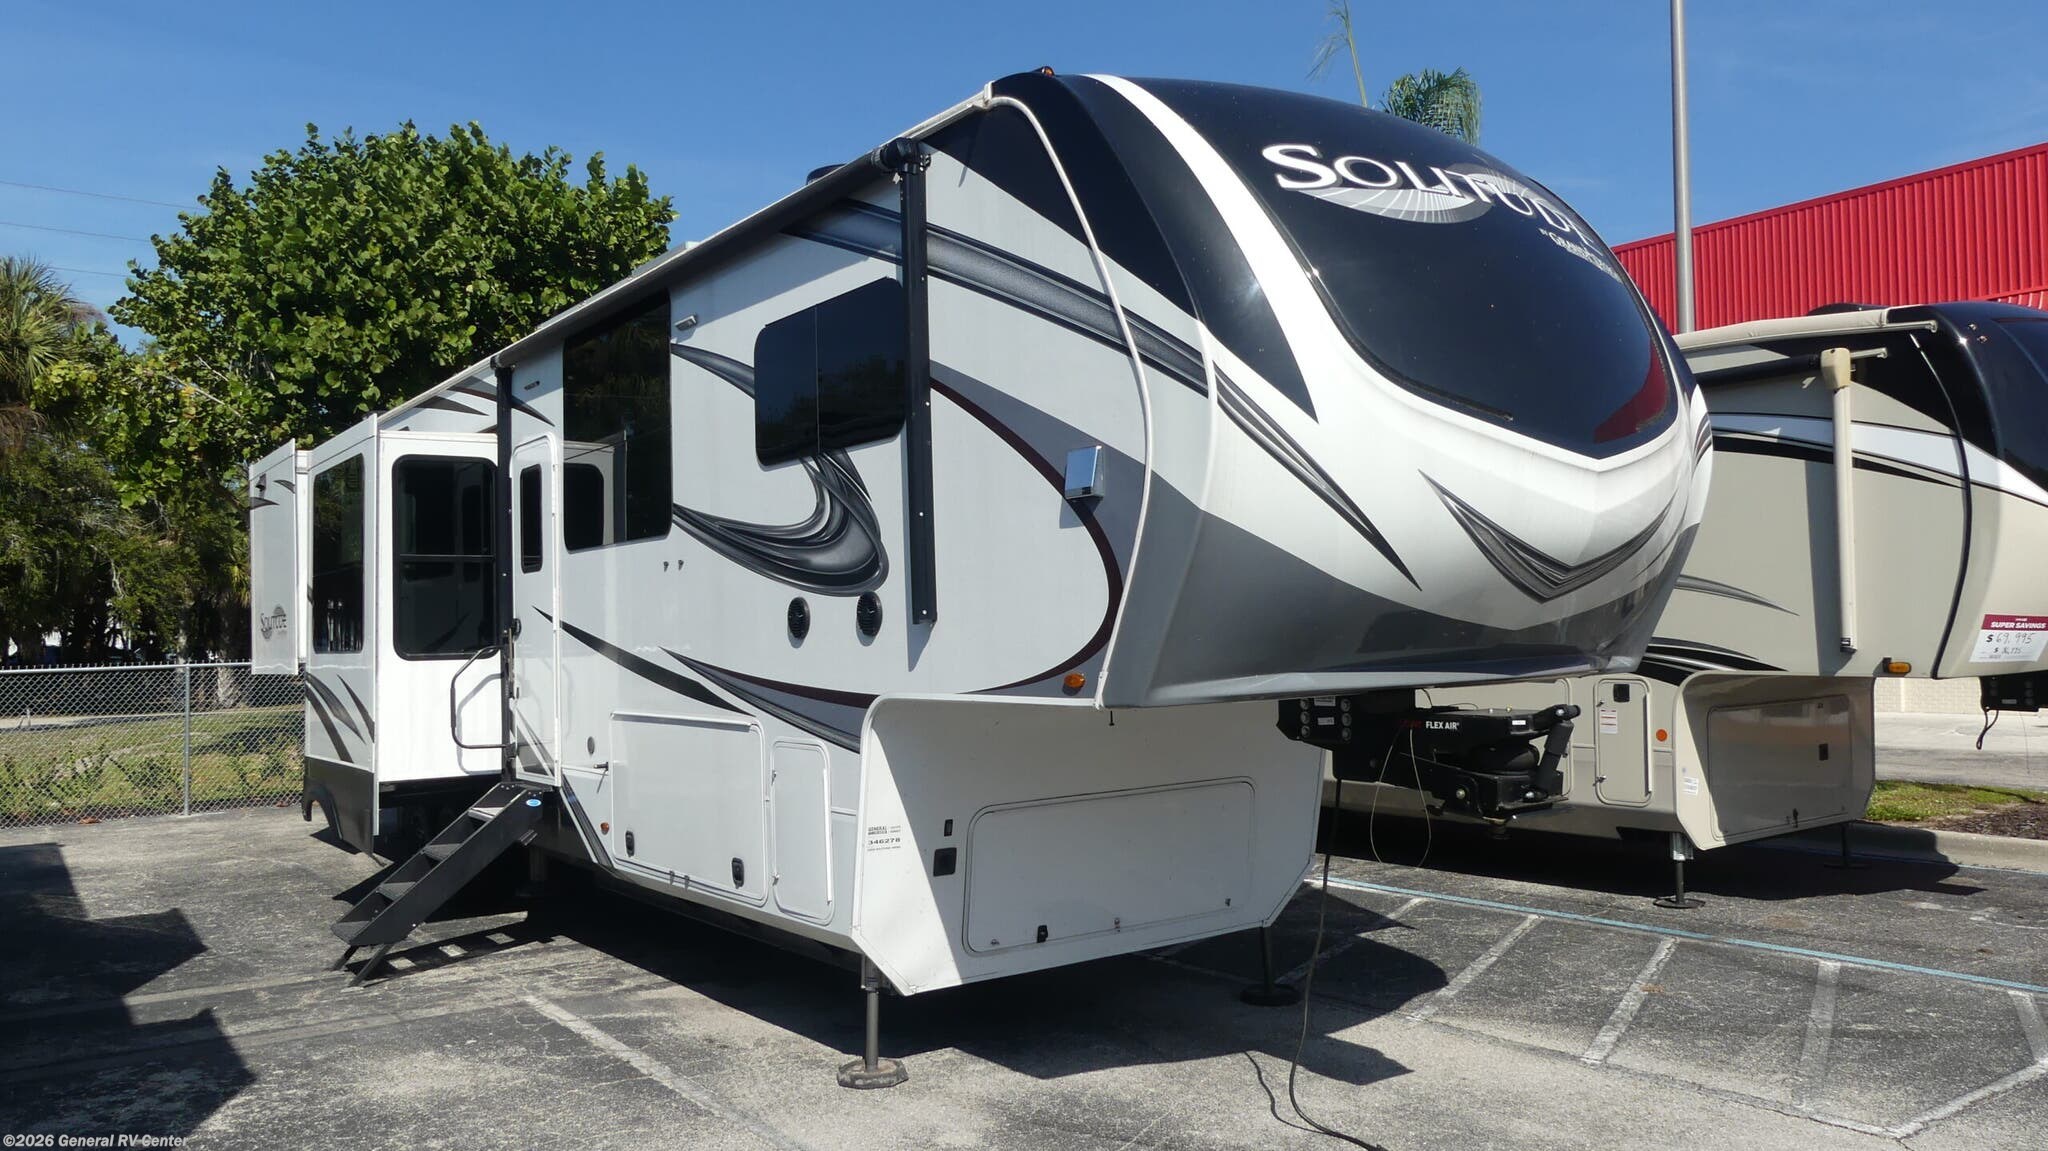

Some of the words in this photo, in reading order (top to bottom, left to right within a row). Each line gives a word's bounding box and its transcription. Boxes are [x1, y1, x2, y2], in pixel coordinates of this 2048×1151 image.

[1261, 143, 1604, 257] SOLITUDE
[1990, 621, 2016, 629] SUPER
[1425, 720, 1444, 729] FLEX
